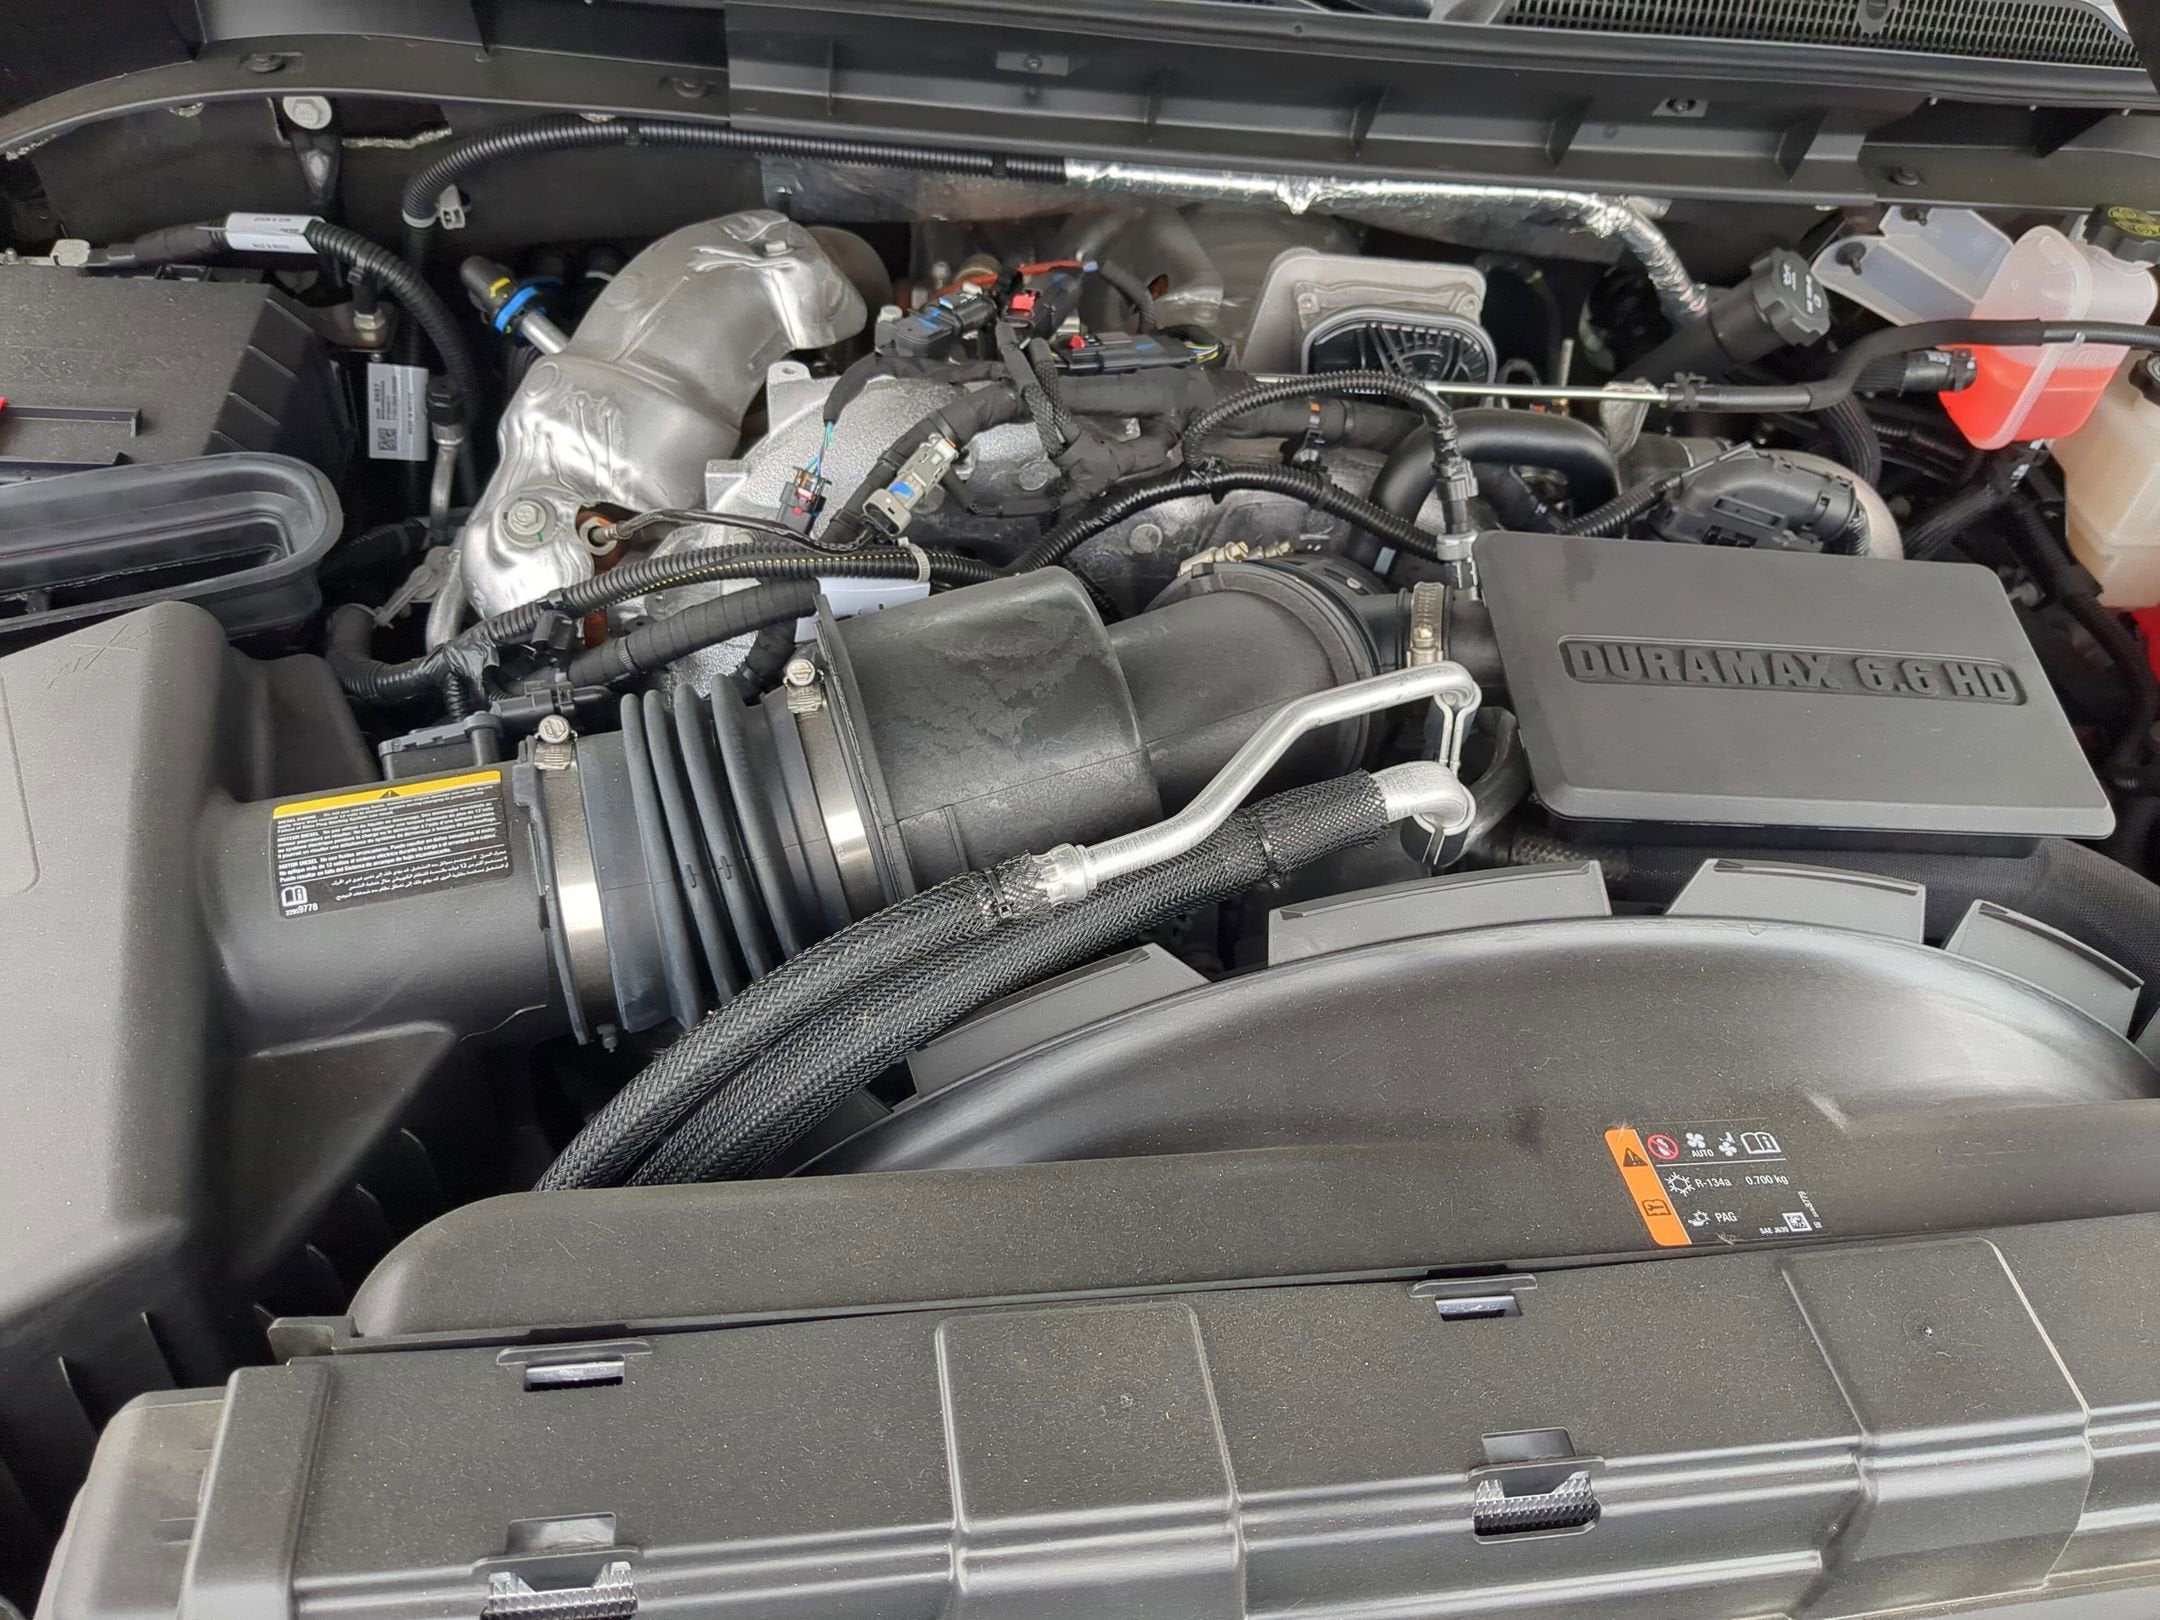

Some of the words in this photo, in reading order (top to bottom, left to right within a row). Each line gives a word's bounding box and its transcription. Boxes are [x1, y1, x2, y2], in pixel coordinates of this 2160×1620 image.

[1566, 642, 1842, 690] DURAMAX
[1853, 656, 1940, 696] 6.6
[1941, 660, 2017, 700] HD
[1691, 1149, 1714, 1158] AUTO
[1695, 1178, 1732, 1188] R-134a
[1745, 1175, 1773, 1186] 0.700
[1773, 1174, 1789, 1186] kg
[1715, 1212, 1738, 1223] PAG
